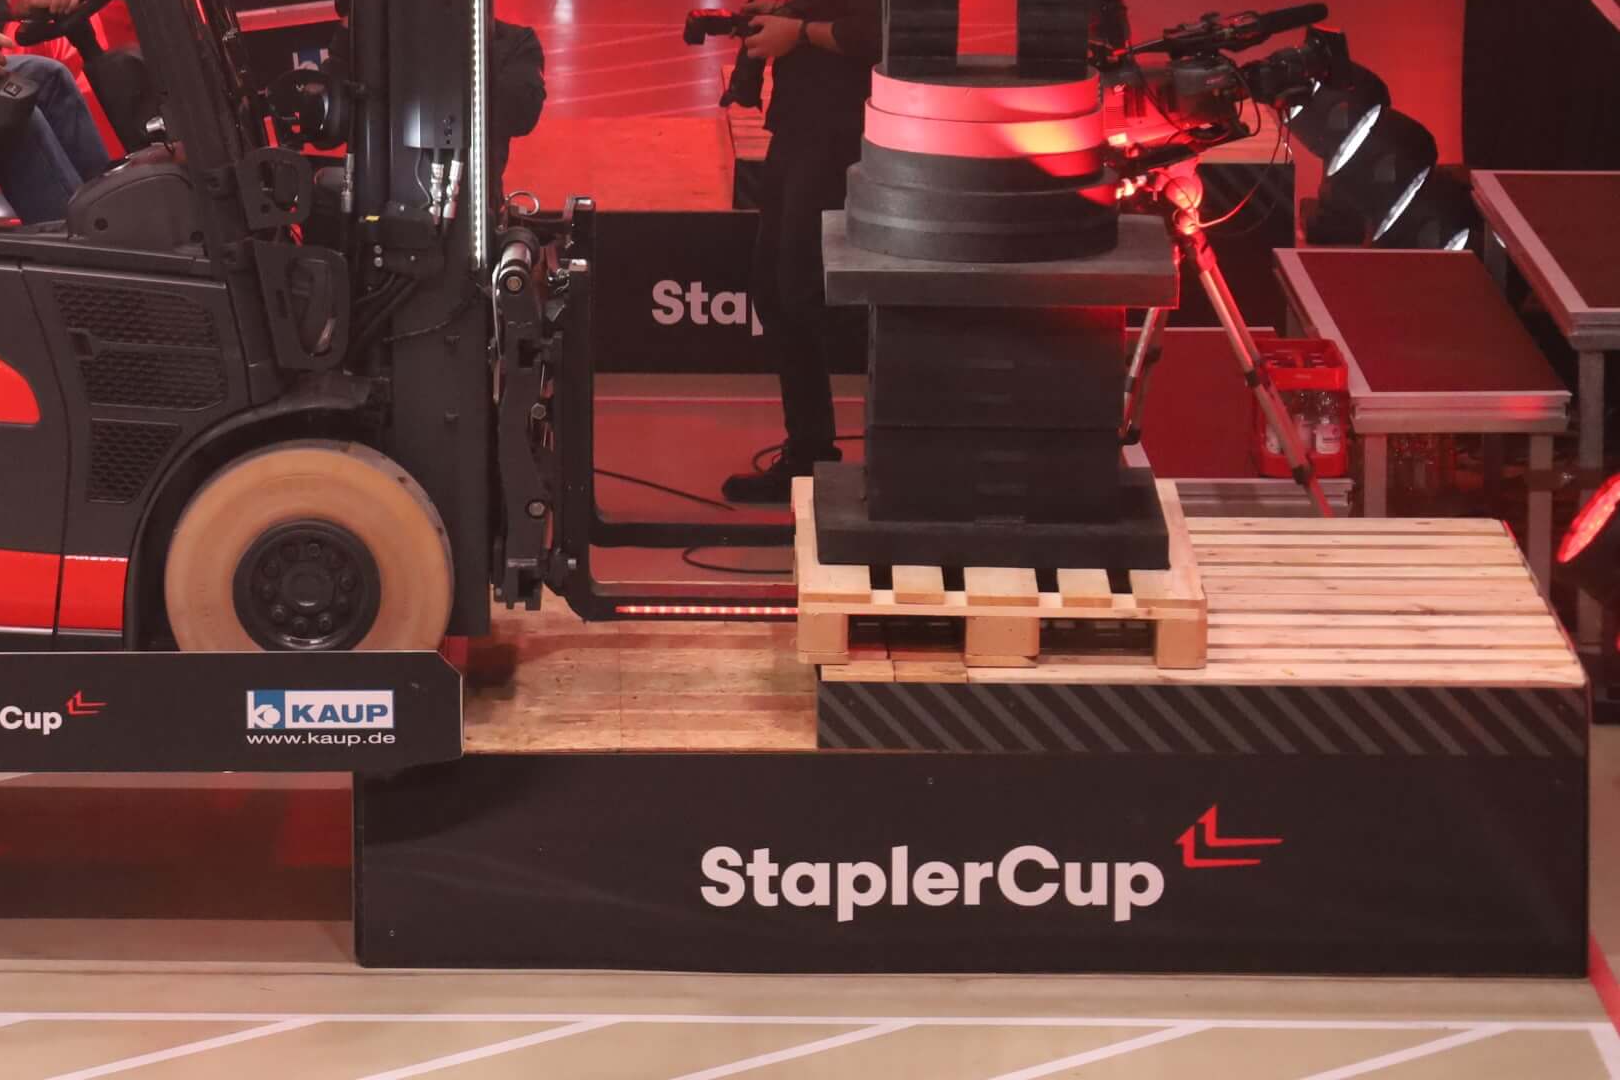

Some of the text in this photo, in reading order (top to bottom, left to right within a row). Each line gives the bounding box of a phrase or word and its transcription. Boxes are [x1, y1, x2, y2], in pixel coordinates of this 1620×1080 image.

[291, 704, 389, 723] KAUP
[246, 732, 396, 746] www.kaup.de
[700, 844, 1165, 922] StaplerCup
